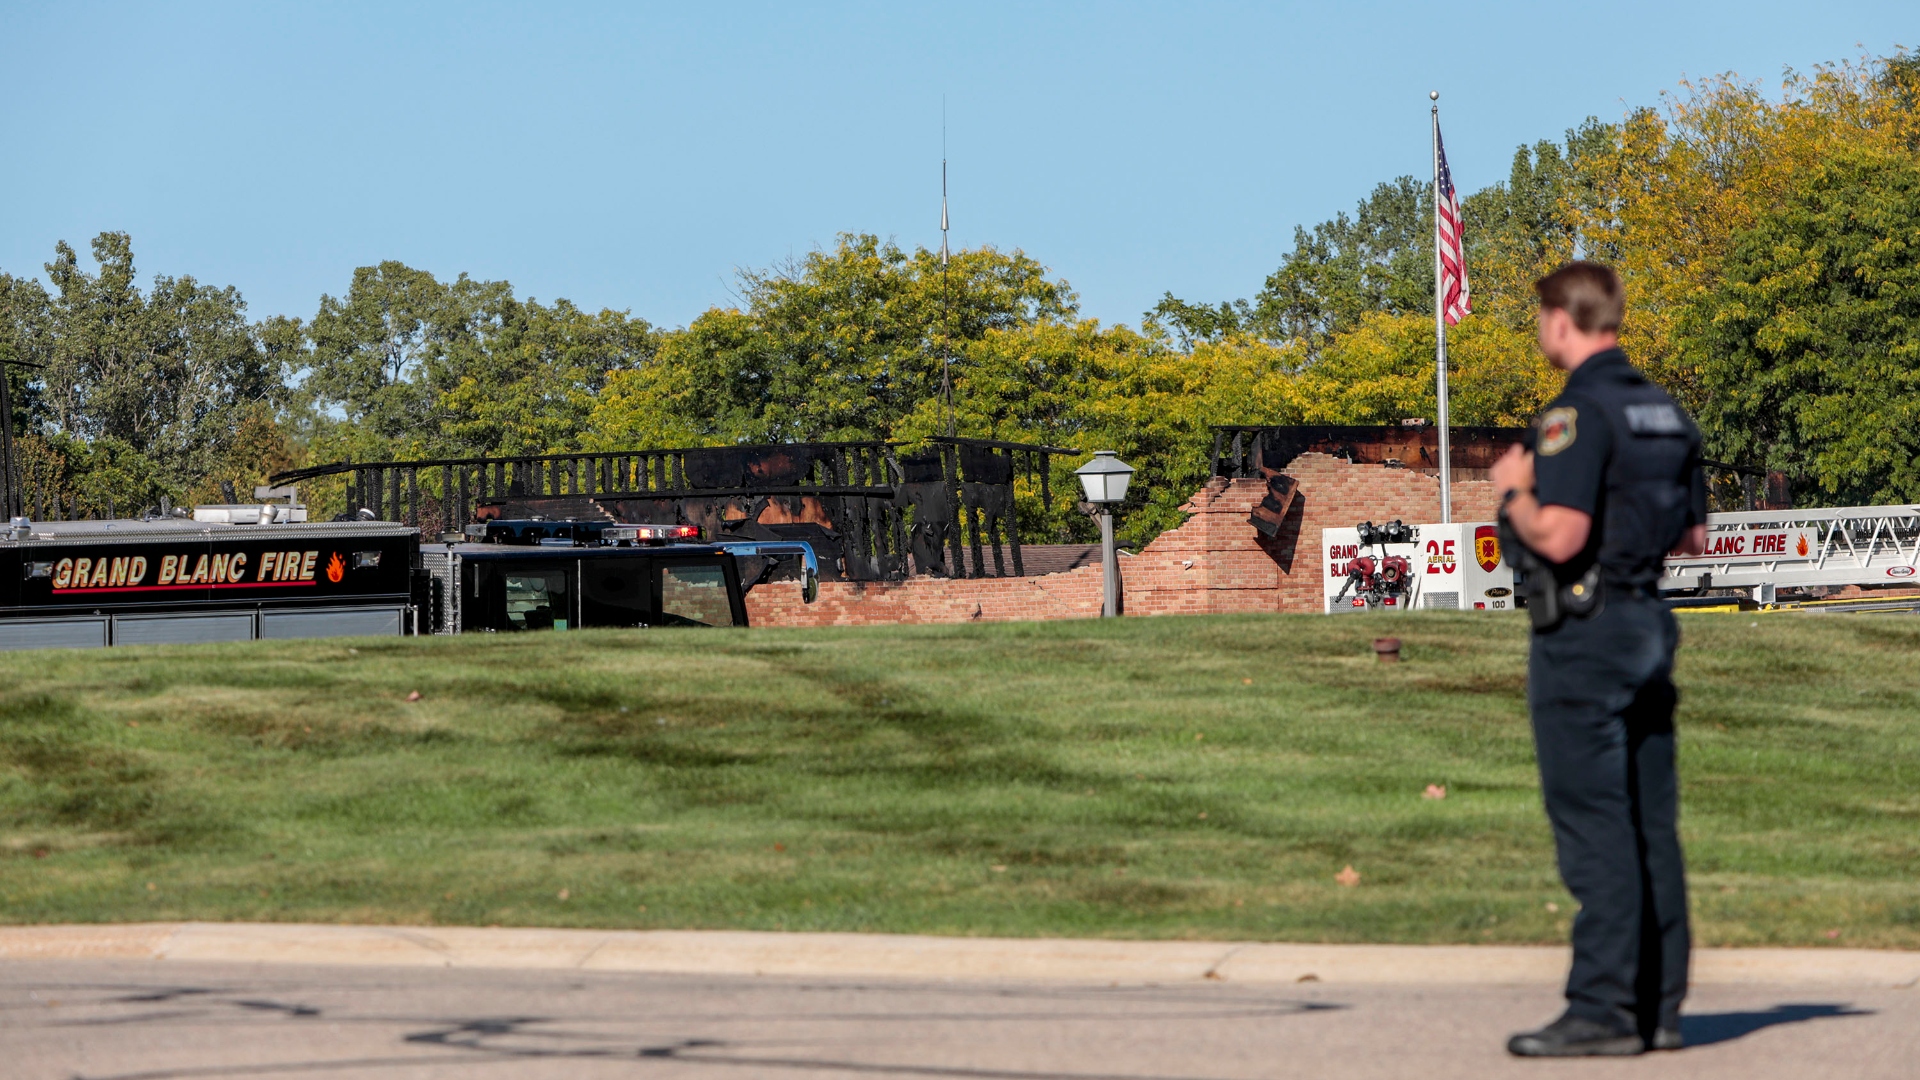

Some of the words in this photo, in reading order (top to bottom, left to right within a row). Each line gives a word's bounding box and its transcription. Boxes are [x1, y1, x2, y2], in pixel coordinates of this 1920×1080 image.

[1330, 545, 1358, 559] GRAND
[1703, 536, 1745, 554] LANC
[1753, 534, 1786, 553] FIRE
[1426, 540, 1456, 574] 25
[52, 556, 147, 589] GRAND
[158, 552, 247, 585] BLANC
[257, 551, 319, 581] FIRE
[1331, 563, 1350, 577] BLA
[1492, 600, 1506, 609] 100
